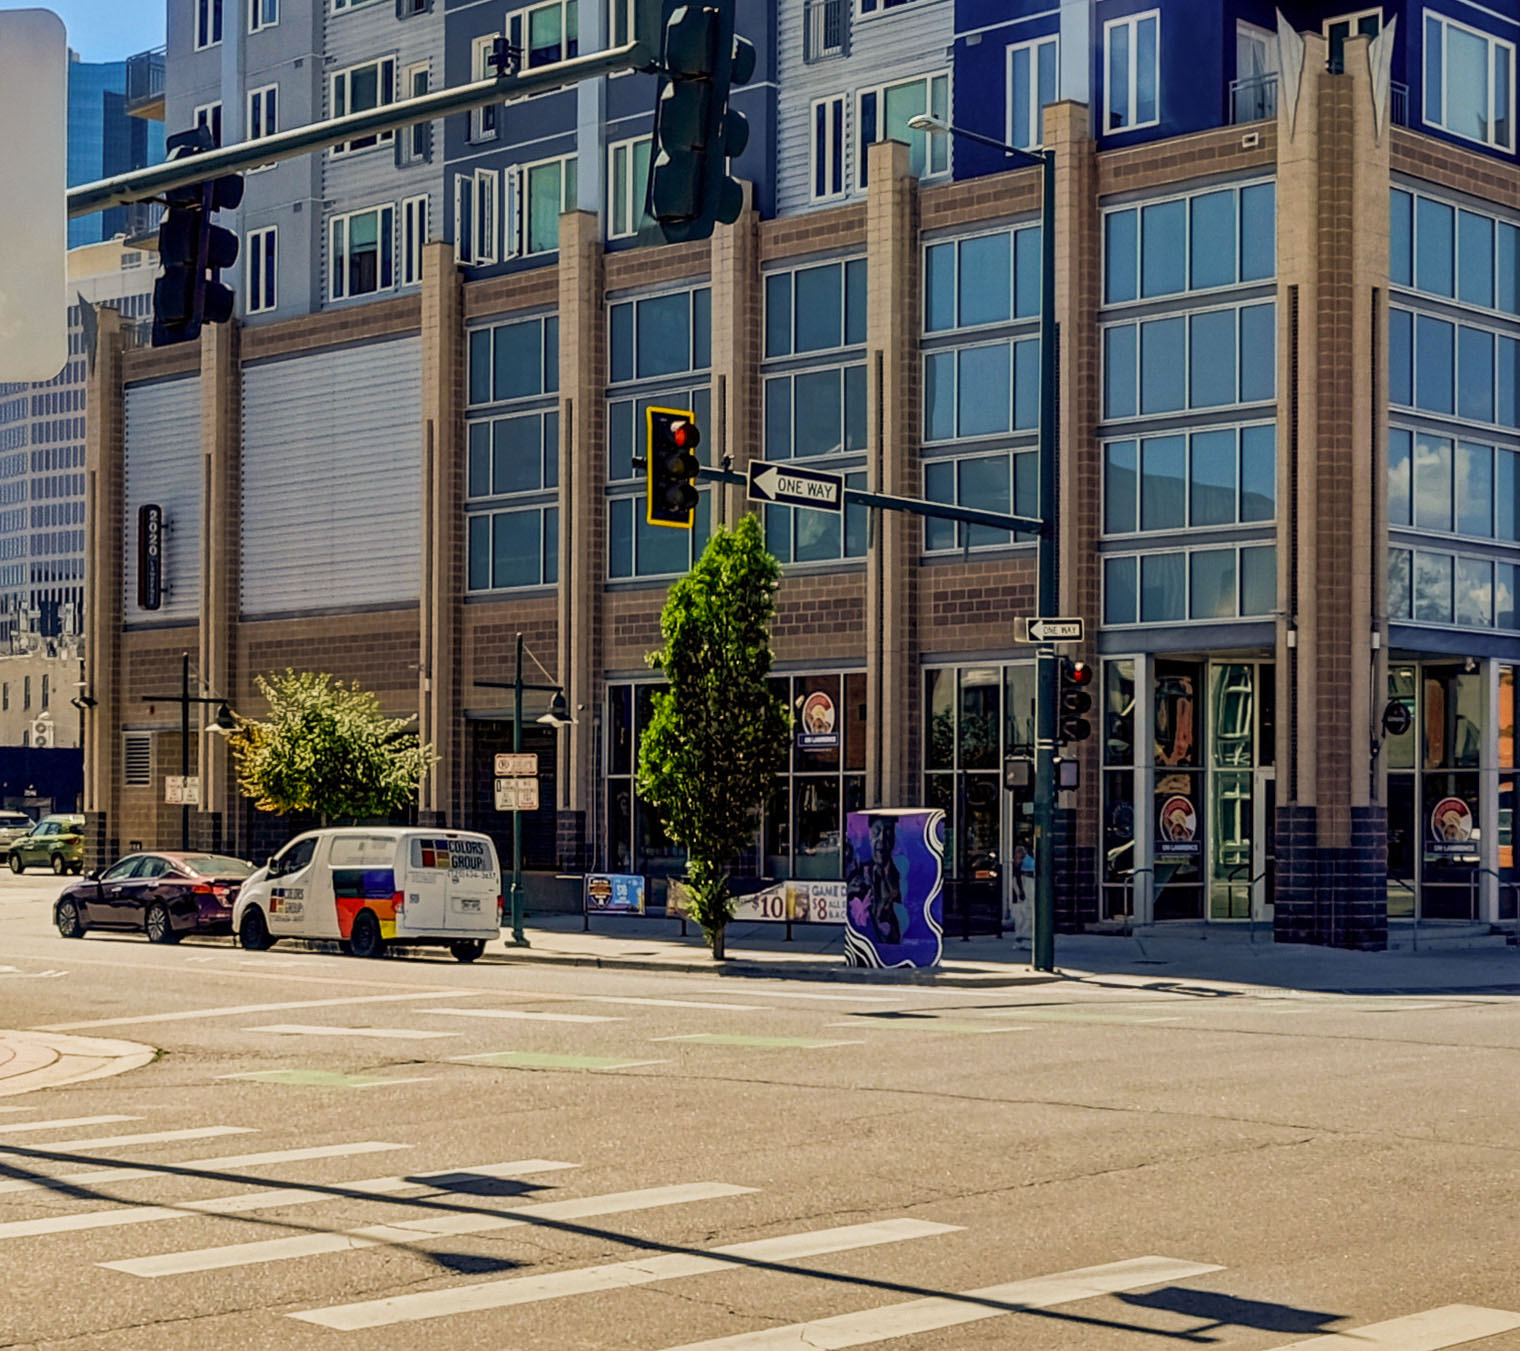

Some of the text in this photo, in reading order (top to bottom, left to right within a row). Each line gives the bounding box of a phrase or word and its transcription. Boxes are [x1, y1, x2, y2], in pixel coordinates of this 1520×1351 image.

[777, 477, 833, 498] ONE WAY
[1043, 626, 1077, 635] ONE WAY
[448, 840, 484, 855] COLORS
[451, 855, 482, 869] GROUP
[812, 885, 838, 897] GAME
[752, 895, 784, 918] $10
[813, 898, 827, 920] $8
